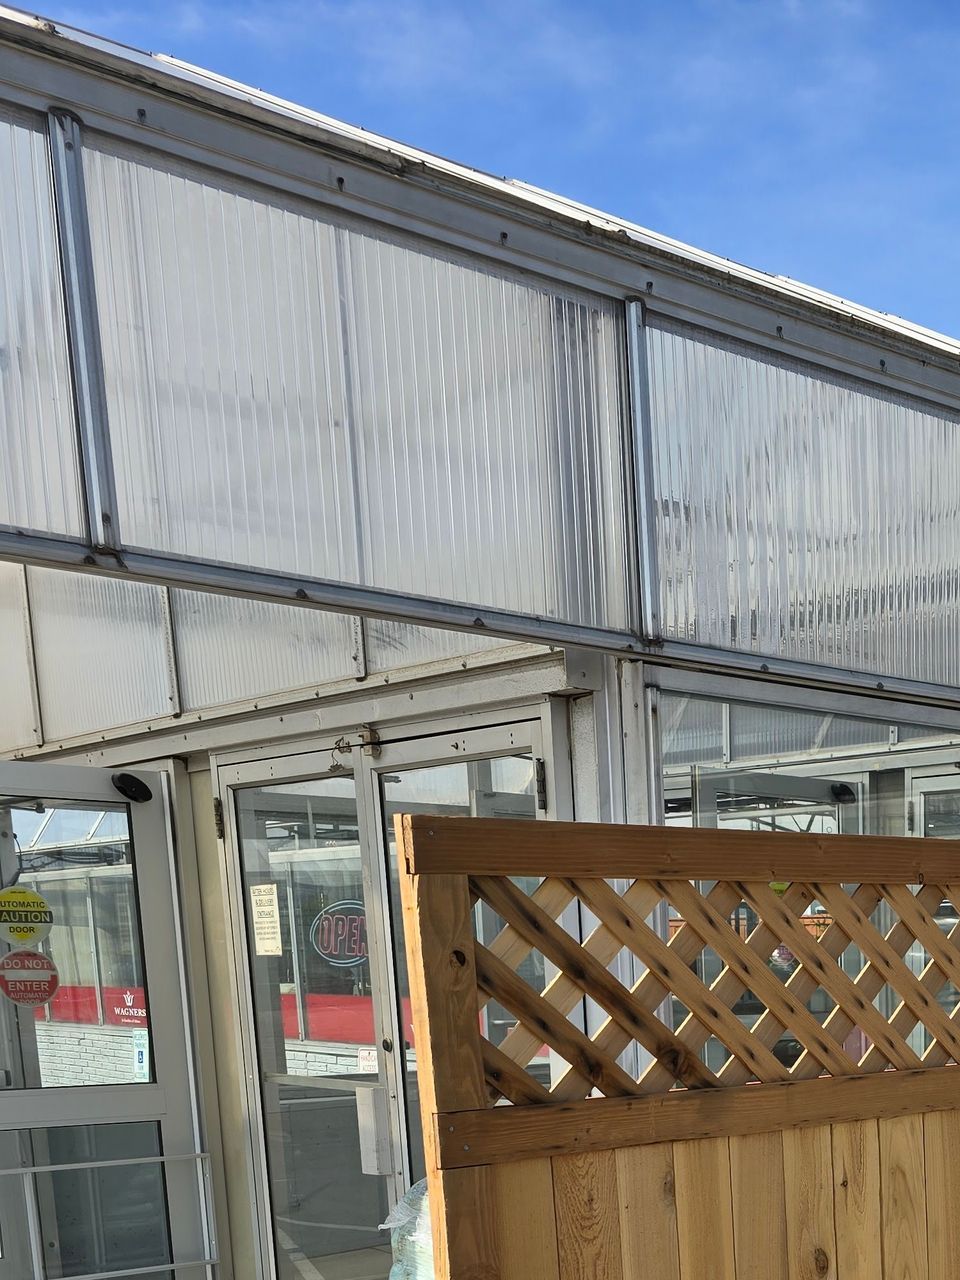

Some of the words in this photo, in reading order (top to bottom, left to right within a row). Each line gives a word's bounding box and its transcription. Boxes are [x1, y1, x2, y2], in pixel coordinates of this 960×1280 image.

[0, 912, 50, 922] AUTION
[4, 960, 21, 968] DO
[25, 960, 49, 968] NOT
[8, 982, 49, 991] ENTER
[114, 1007, 146, 1016] WAGNERS
